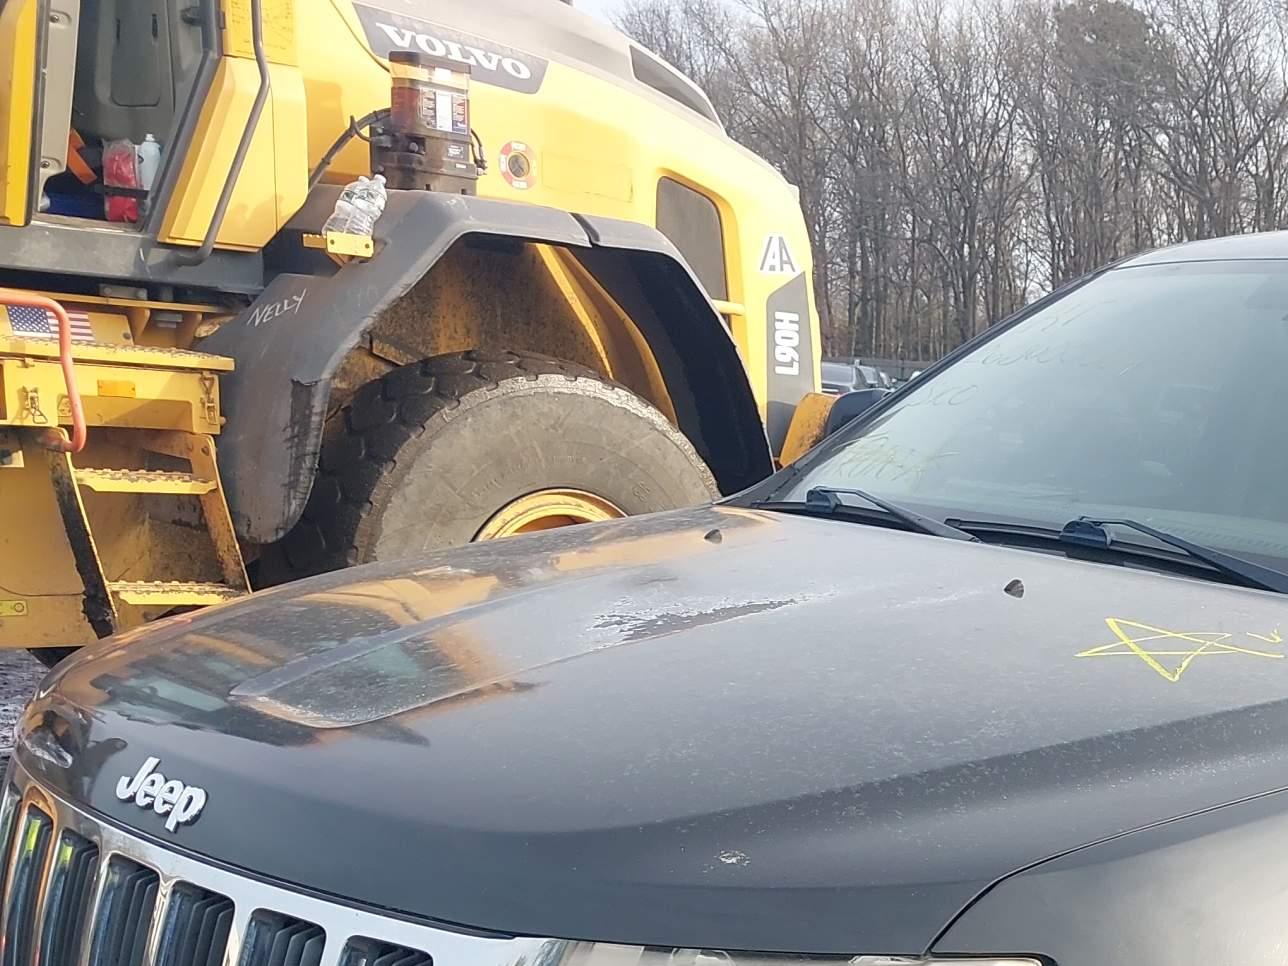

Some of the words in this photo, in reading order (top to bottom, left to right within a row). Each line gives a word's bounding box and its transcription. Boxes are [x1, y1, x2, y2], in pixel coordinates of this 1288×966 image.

[376, 22, 532, 80] VOLVO
[246, 288, 308, 328] NELLY
[773, 311, 800, 376] L90H
[116, 756, 208, 832] Jeep
